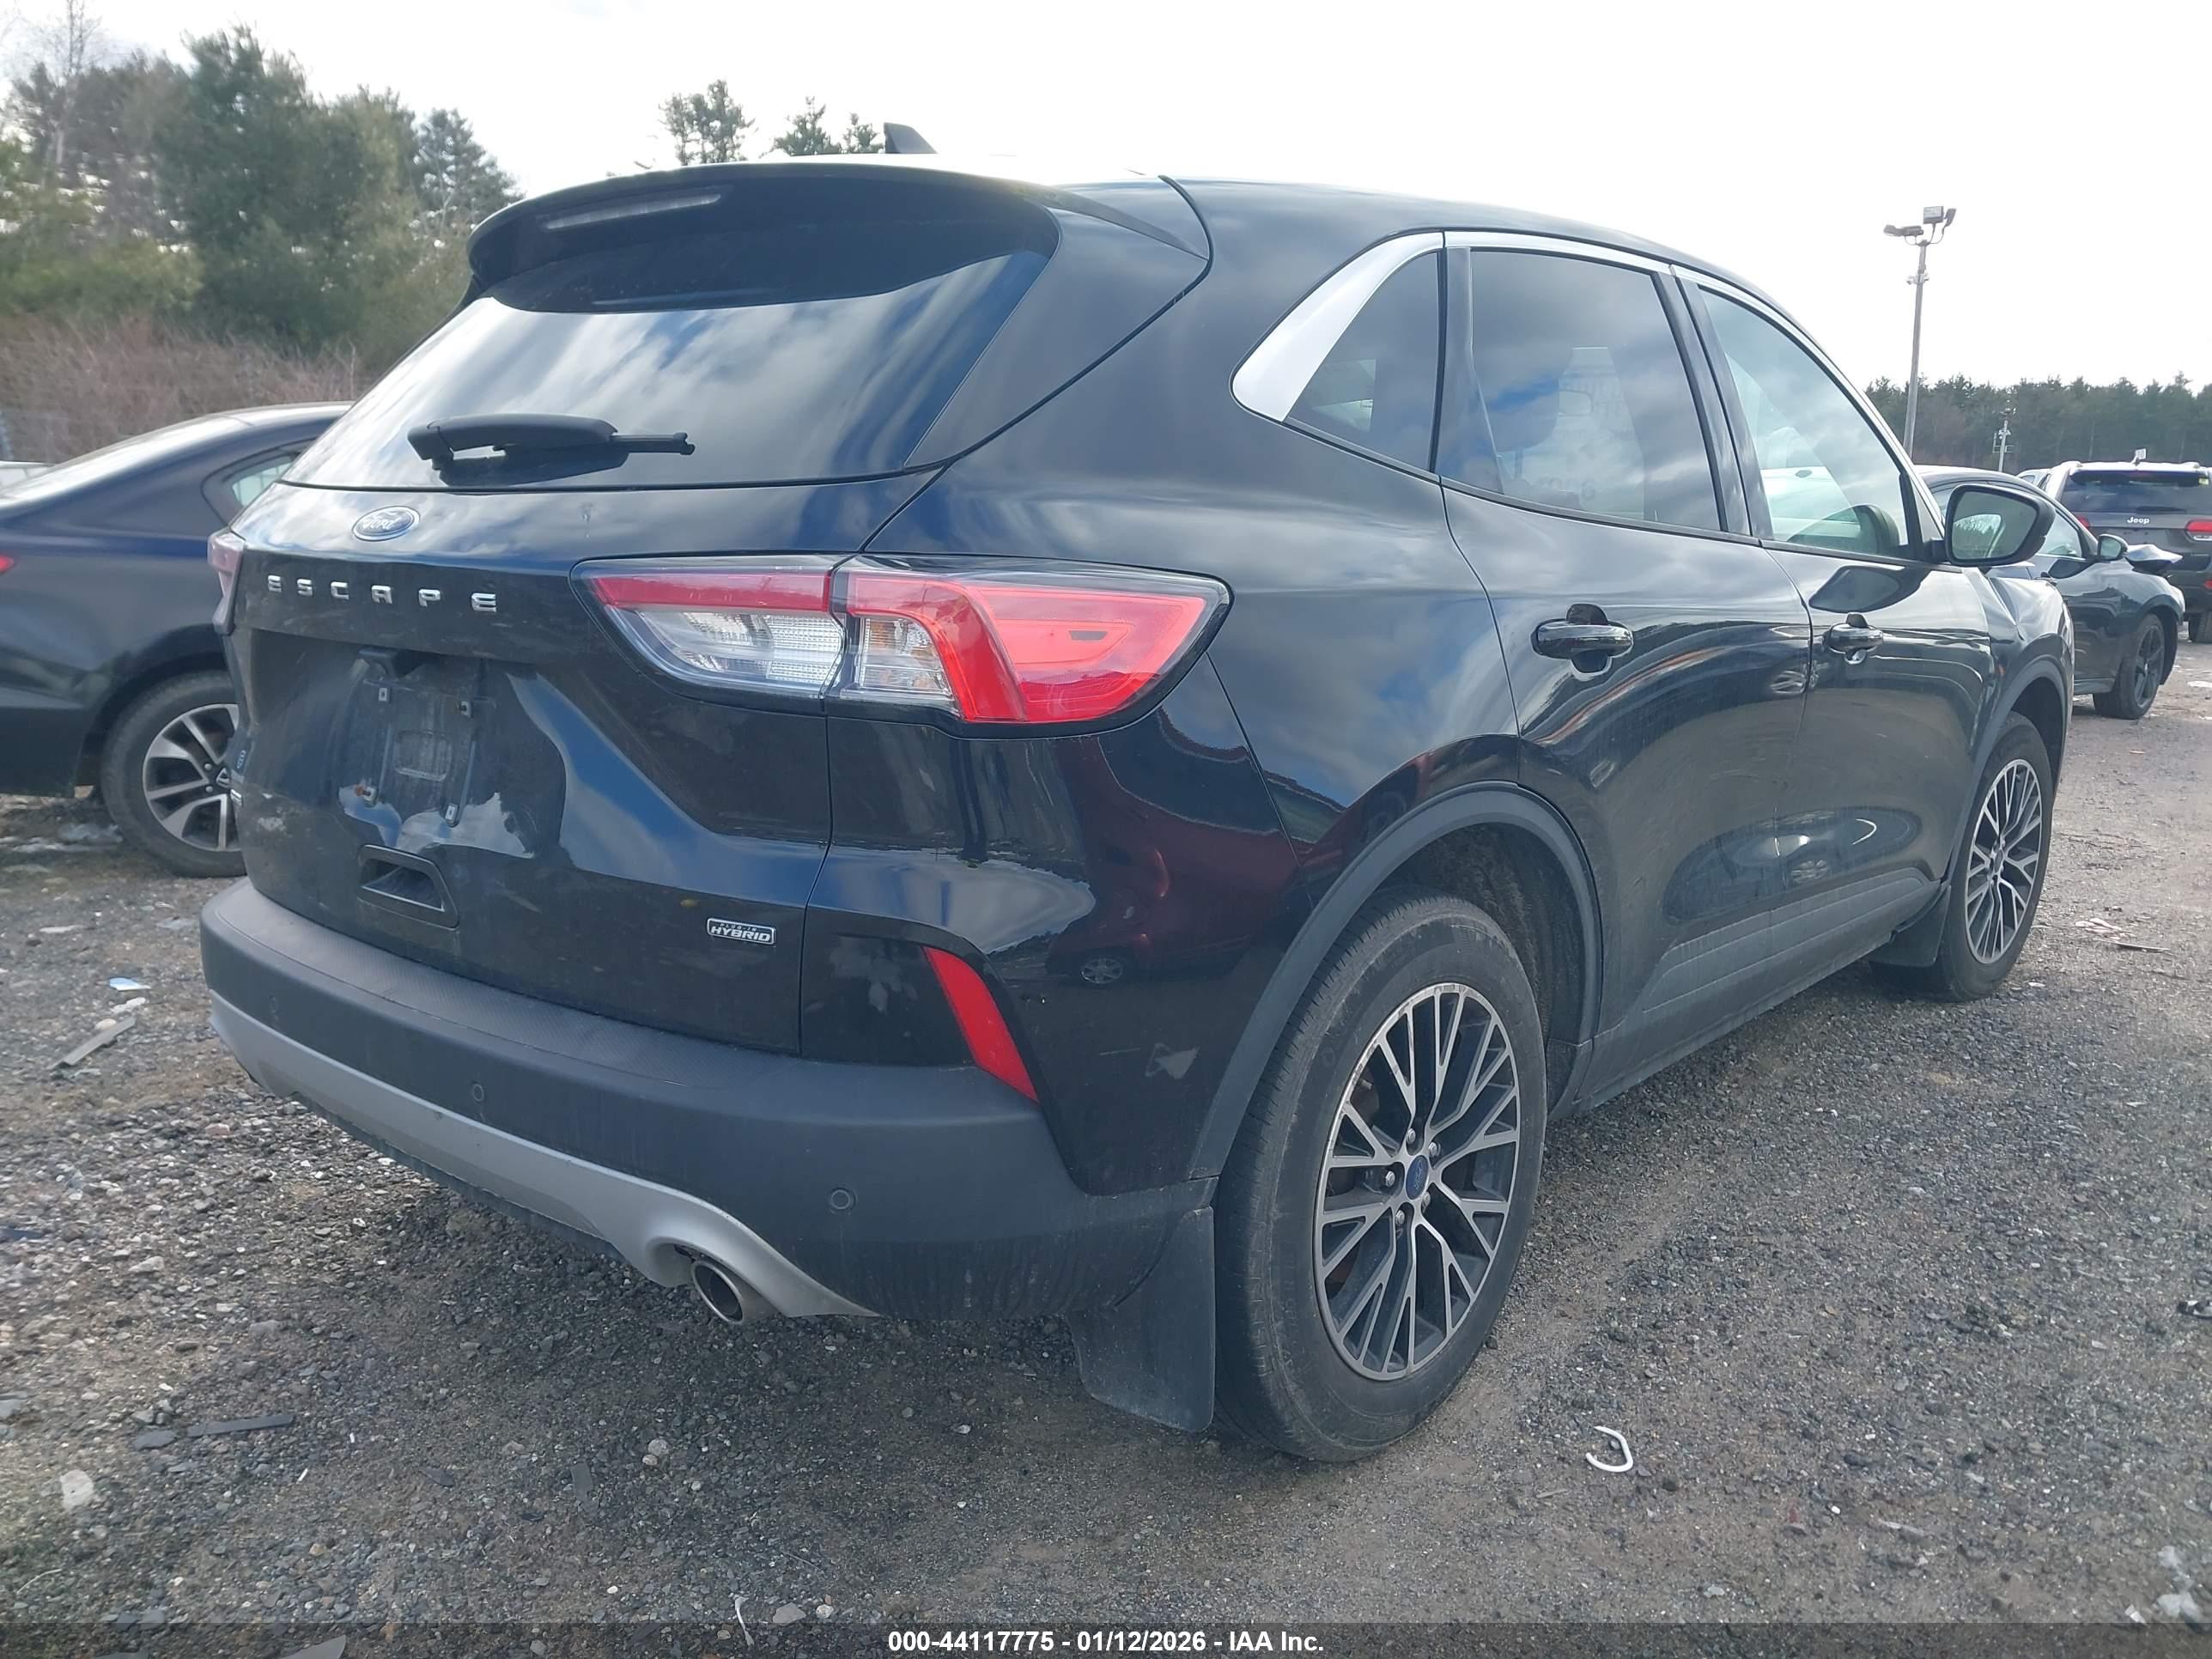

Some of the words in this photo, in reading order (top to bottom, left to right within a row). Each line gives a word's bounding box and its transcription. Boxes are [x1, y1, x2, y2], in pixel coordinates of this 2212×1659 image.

[2126, 516, 2150, 525] Jeep
[267, 574, 497, 612] ESCAPE
[720, 923, 757, 932] PLUG-IN
[710, 926, 771, 942] HYBRID
